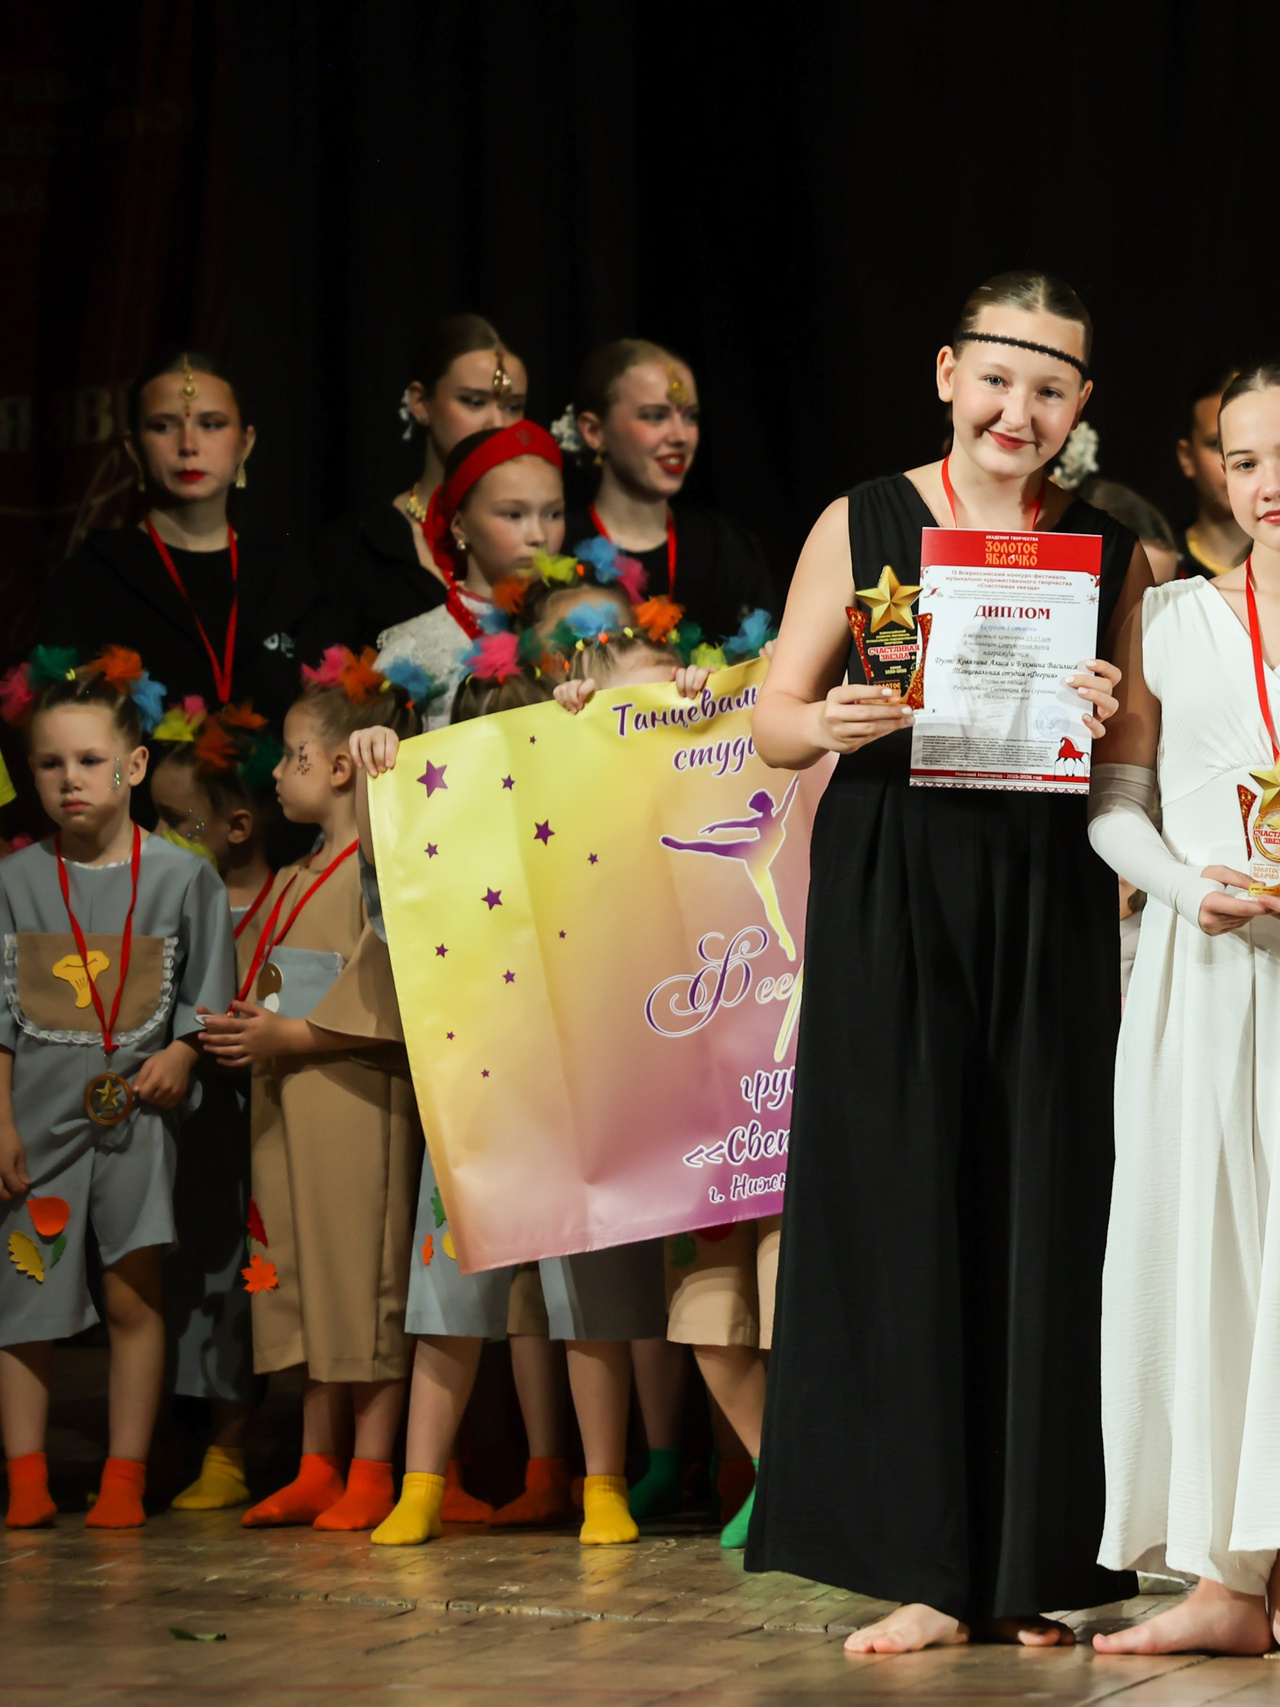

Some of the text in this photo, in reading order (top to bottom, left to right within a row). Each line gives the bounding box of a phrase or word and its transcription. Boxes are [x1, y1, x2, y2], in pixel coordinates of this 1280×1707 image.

[985, 541, 1039, 555] ЗОЛОТОЕ
[985, 553, 1038, 566] ЯБЛОЧКО
[974, 605, 1051, 620] ДИПЛОМ
[868, 644, 920, 656] СЧАСТЛИВАЯ
[880, 652, 911, 661] ЗВЕЗДА
